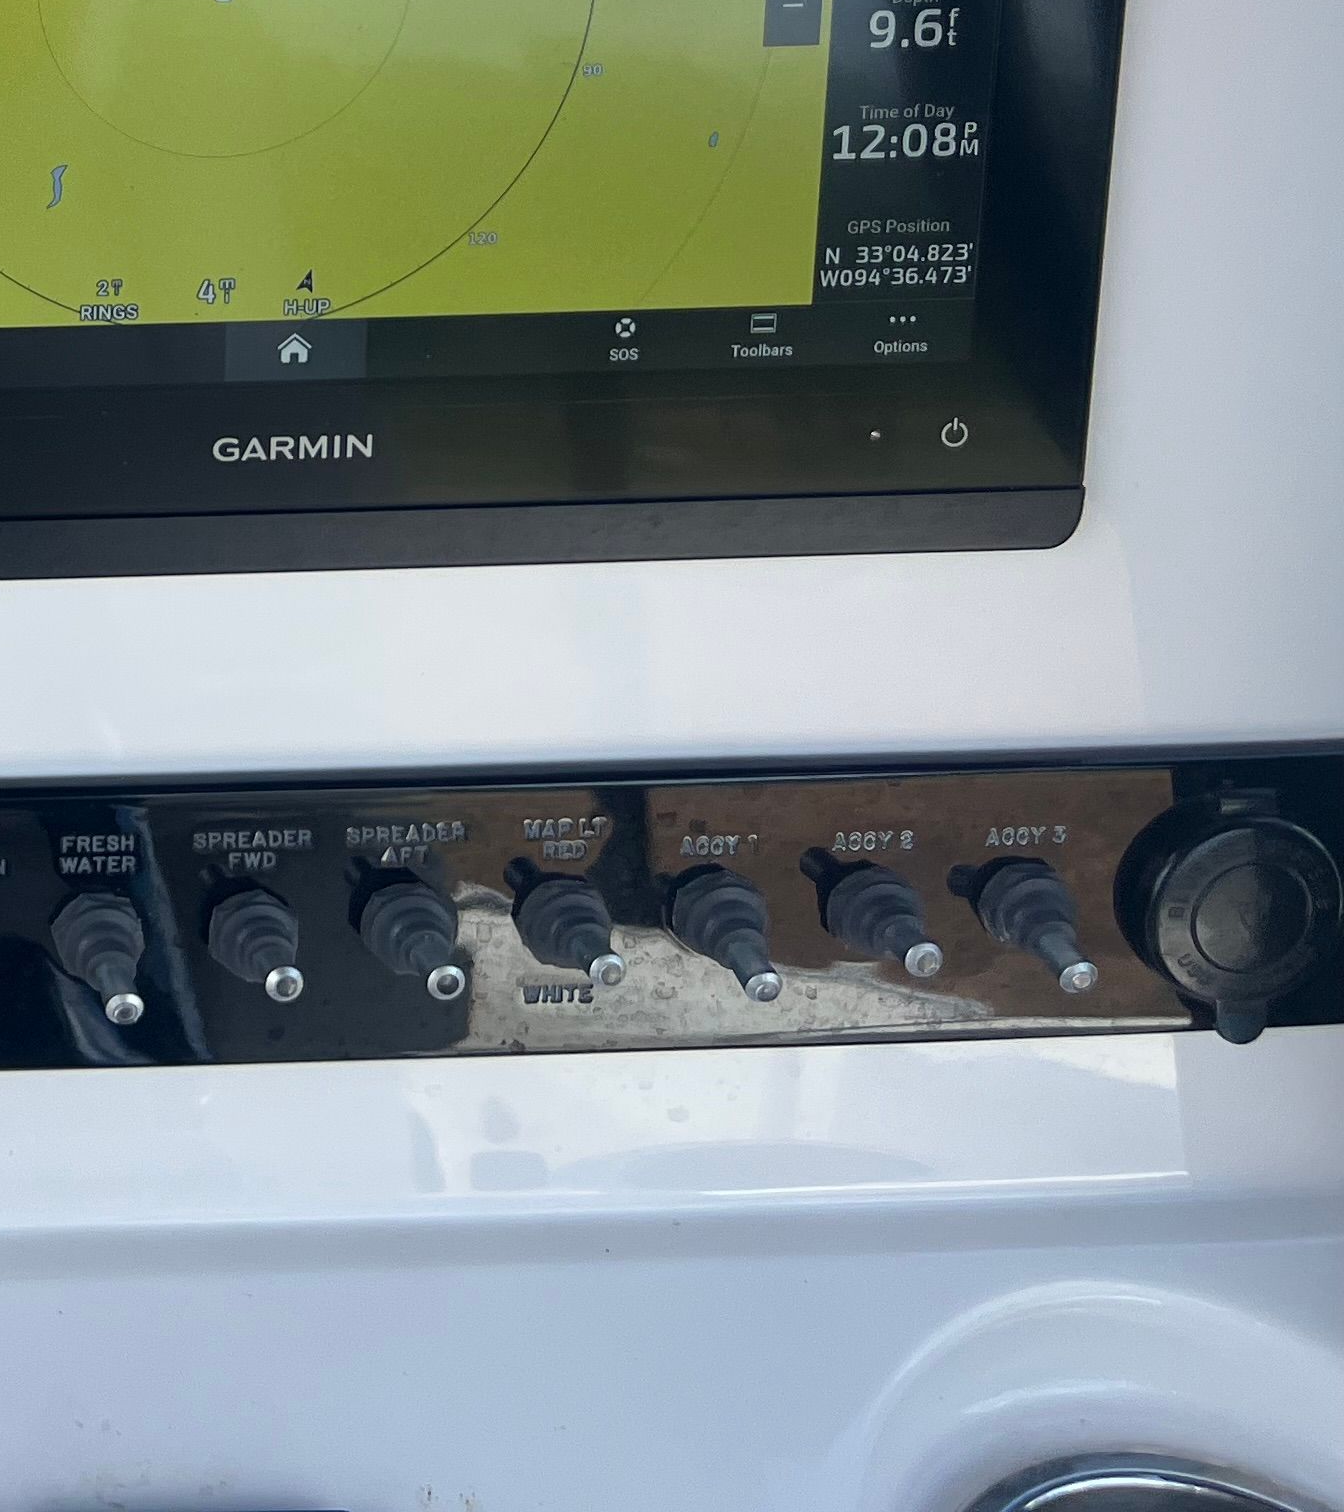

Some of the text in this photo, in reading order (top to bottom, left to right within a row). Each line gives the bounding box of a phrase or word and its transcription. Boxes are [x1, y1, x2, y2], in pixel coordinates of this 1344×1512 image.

[859, 103, 955, 121] Time of Day
[831, 121, 957, 161] 12:08
[846, 218, 951, 235] GPS Position
[468, 231, 499, 246] 120
[824, 247, 841, 265] N
[79, 302, 140, 323] RINGS
[282, 297, 331, 317] H-UP
[609, 348, 639, 362] SOS
[730, 342, 794, 359] Toolbars
[873, 338, 929, 356] Options
[211, 433, 375, 463] GARMIN
[192, 829, 314, 850] SPREADER
[346, 820, 467, 845] SPREADER
[1051, 824, 1068, 845] 3
[60, 834, 137, 854] FRESH
[59, 854, 138, 875] WATER
[227, 850, 278, 871] FWD
[380, 844, 431, 866] AFT
[520, 982, 595, 1005] WHITE
